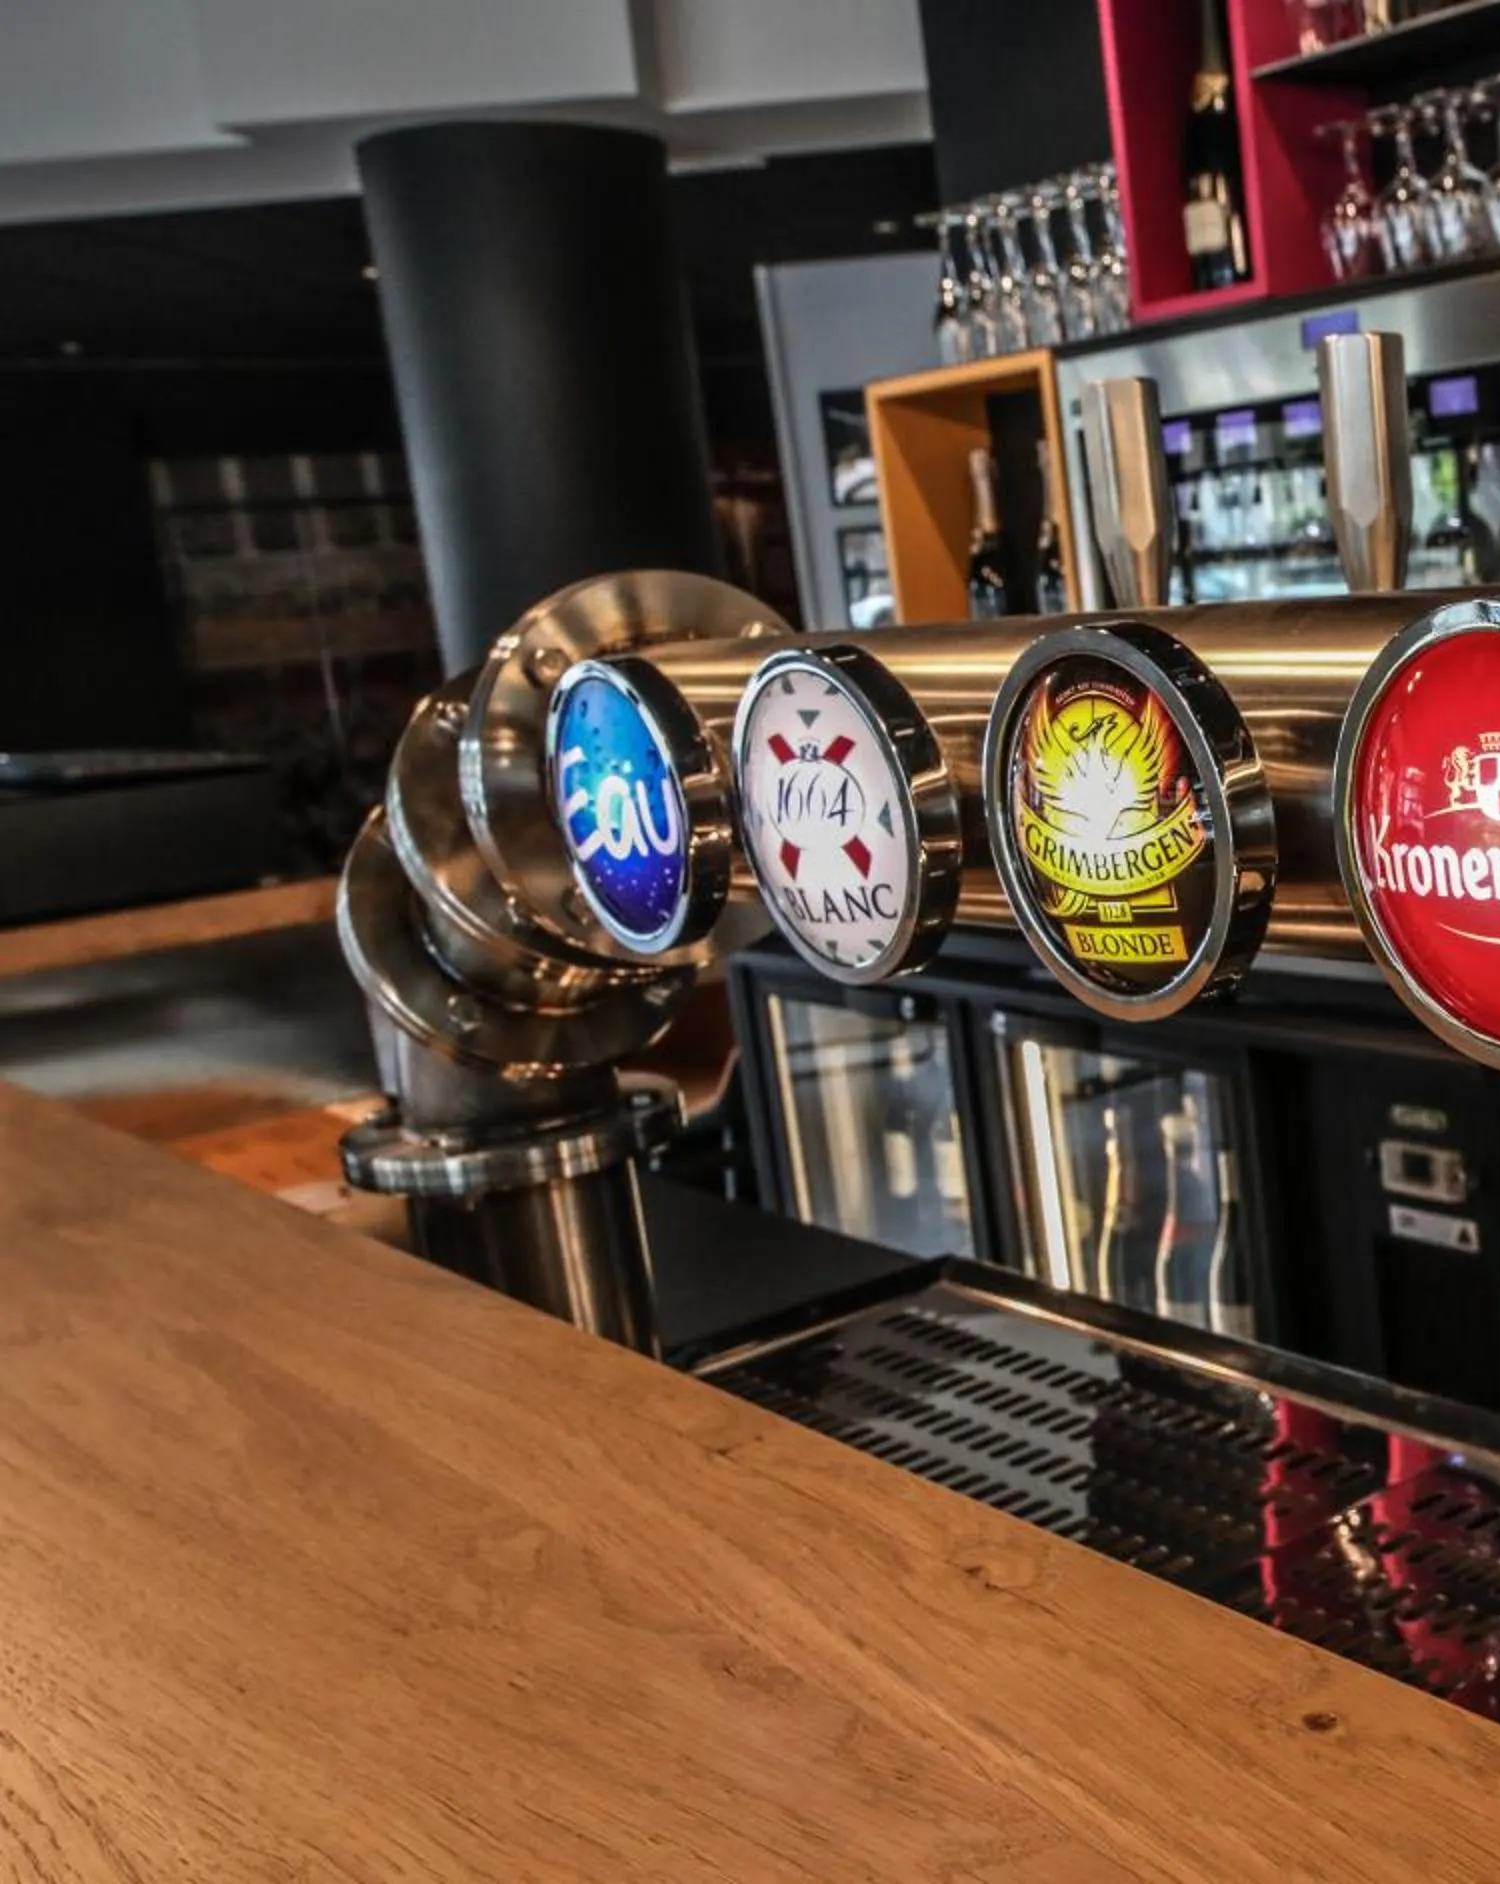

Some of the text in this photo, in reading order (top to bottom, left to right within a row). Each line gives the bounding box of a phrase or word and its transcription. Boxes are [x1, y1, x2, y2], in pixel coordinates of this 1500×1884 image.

[560, 746, 679, 862] Eau
[777, 771, 854, 828] 1664
[1025, 821, 1196, 882] GRIMBERGEN
[784, 882, 898, 924] BLANC
[1076, 931, 1175, 957] BLONDE
